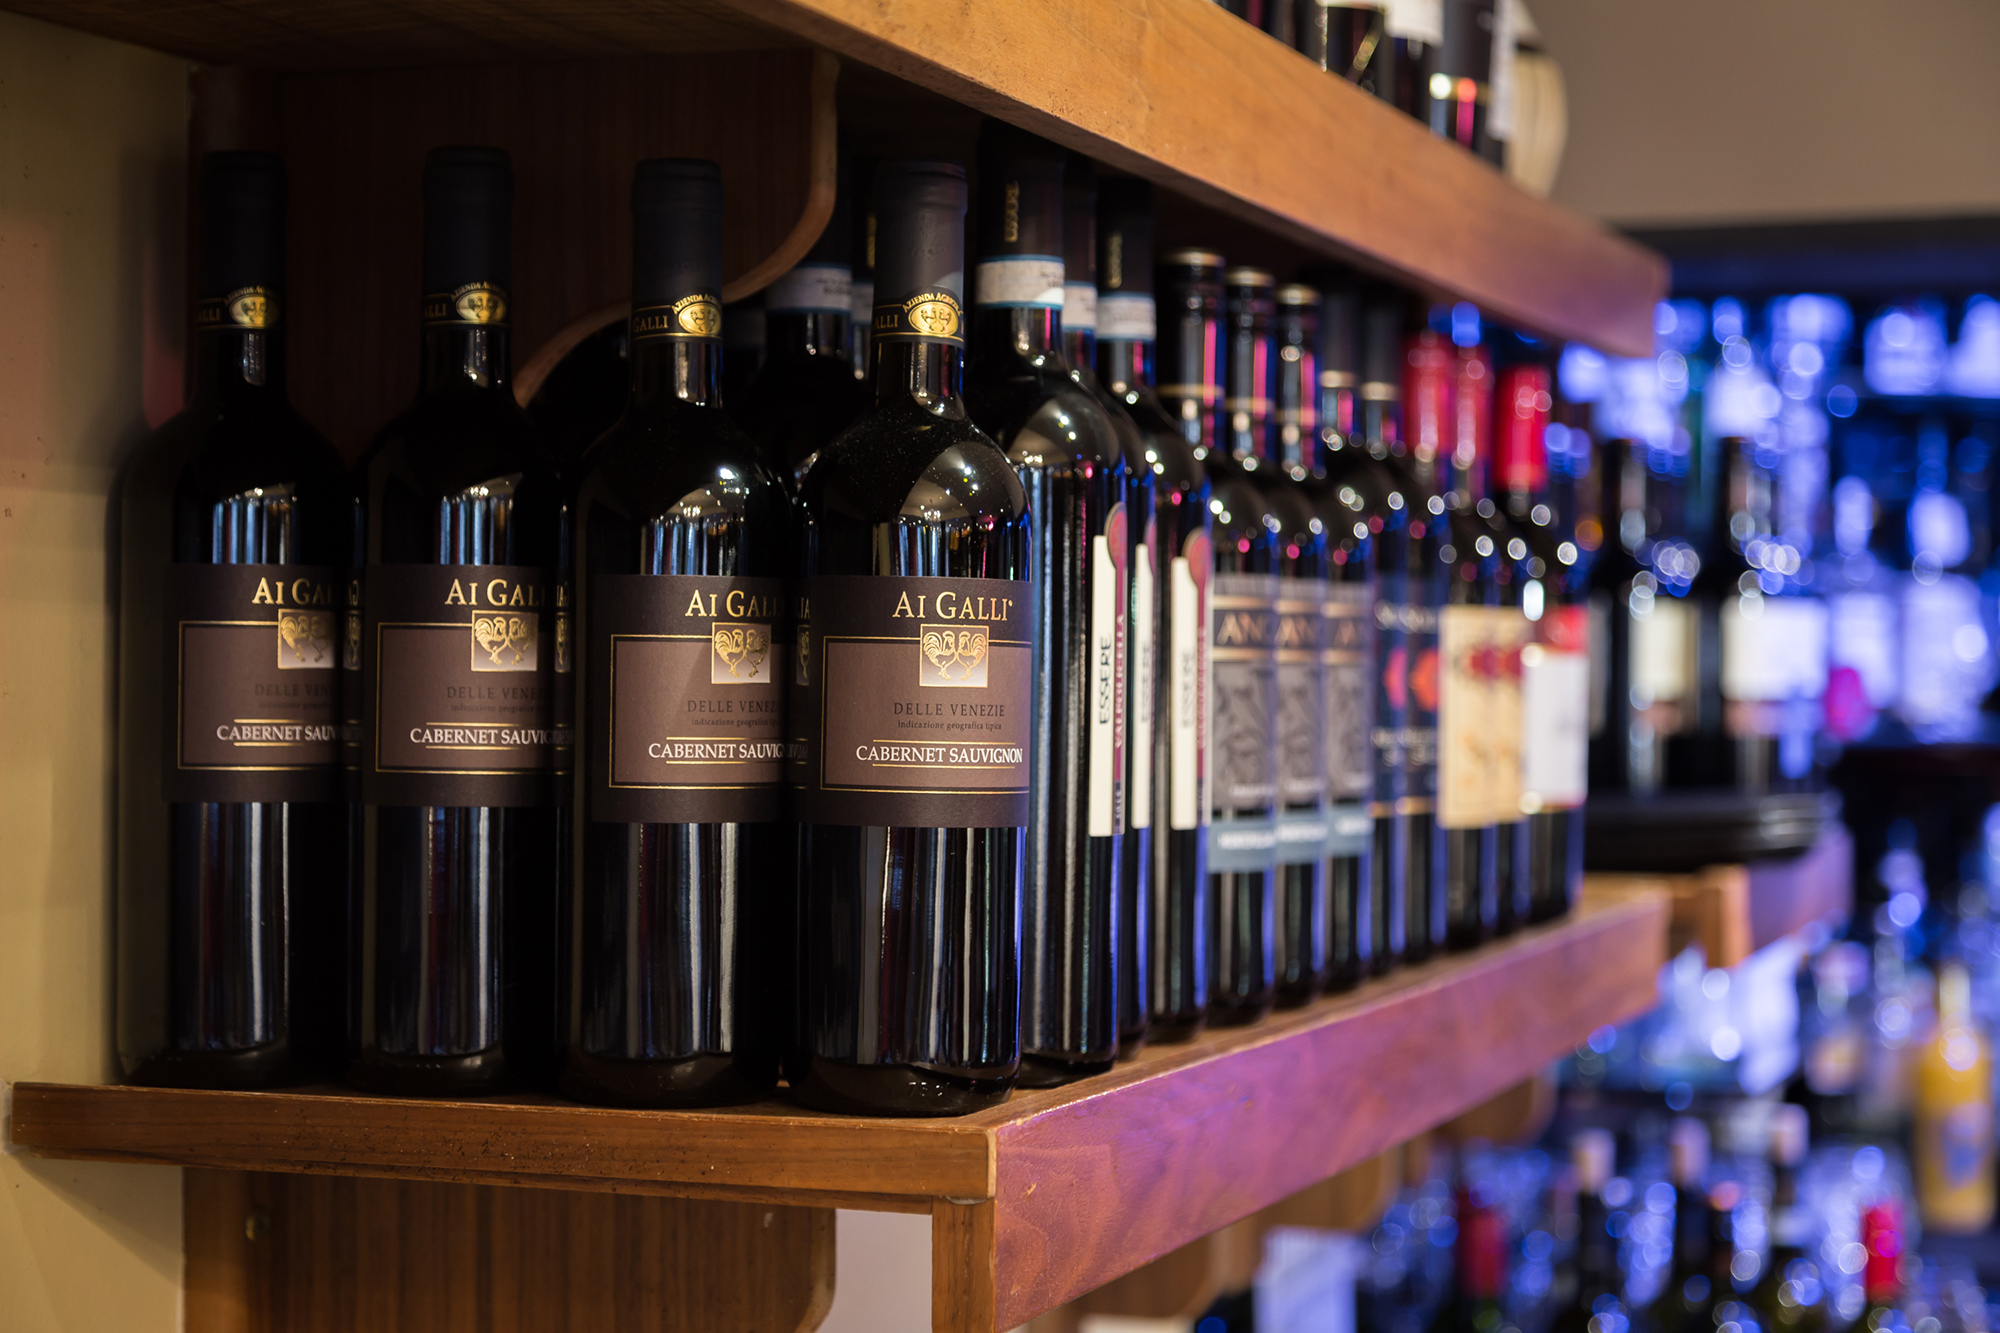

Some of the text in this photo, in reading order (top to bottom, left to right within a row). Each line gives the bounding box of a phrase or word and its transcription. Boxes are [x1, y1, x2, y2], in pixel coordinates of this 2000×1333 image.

[902, 293, 935, 313] AZIENDA
[873, 313, 899, 329] ALLI
[1099, 636, 1111, 725] ESSERE
[447, 686, 495, 699] DELLE
[687, 700, 733, 713] DELLE
[894, 702, 1005, 717] DELLE VENEZIE
[692, 718, 734, 726] indicazione
[897, 720, 944, 728] indicazione
[946, 722, 983, 731] geografica
[216, 725, 302, 741] CABERNET
[410, 728, 499, 744] CABERNET
[648, 743, 736, 759] CABERNET
[856, 745, 1023, 764] CABERNET SAUVIGNON
